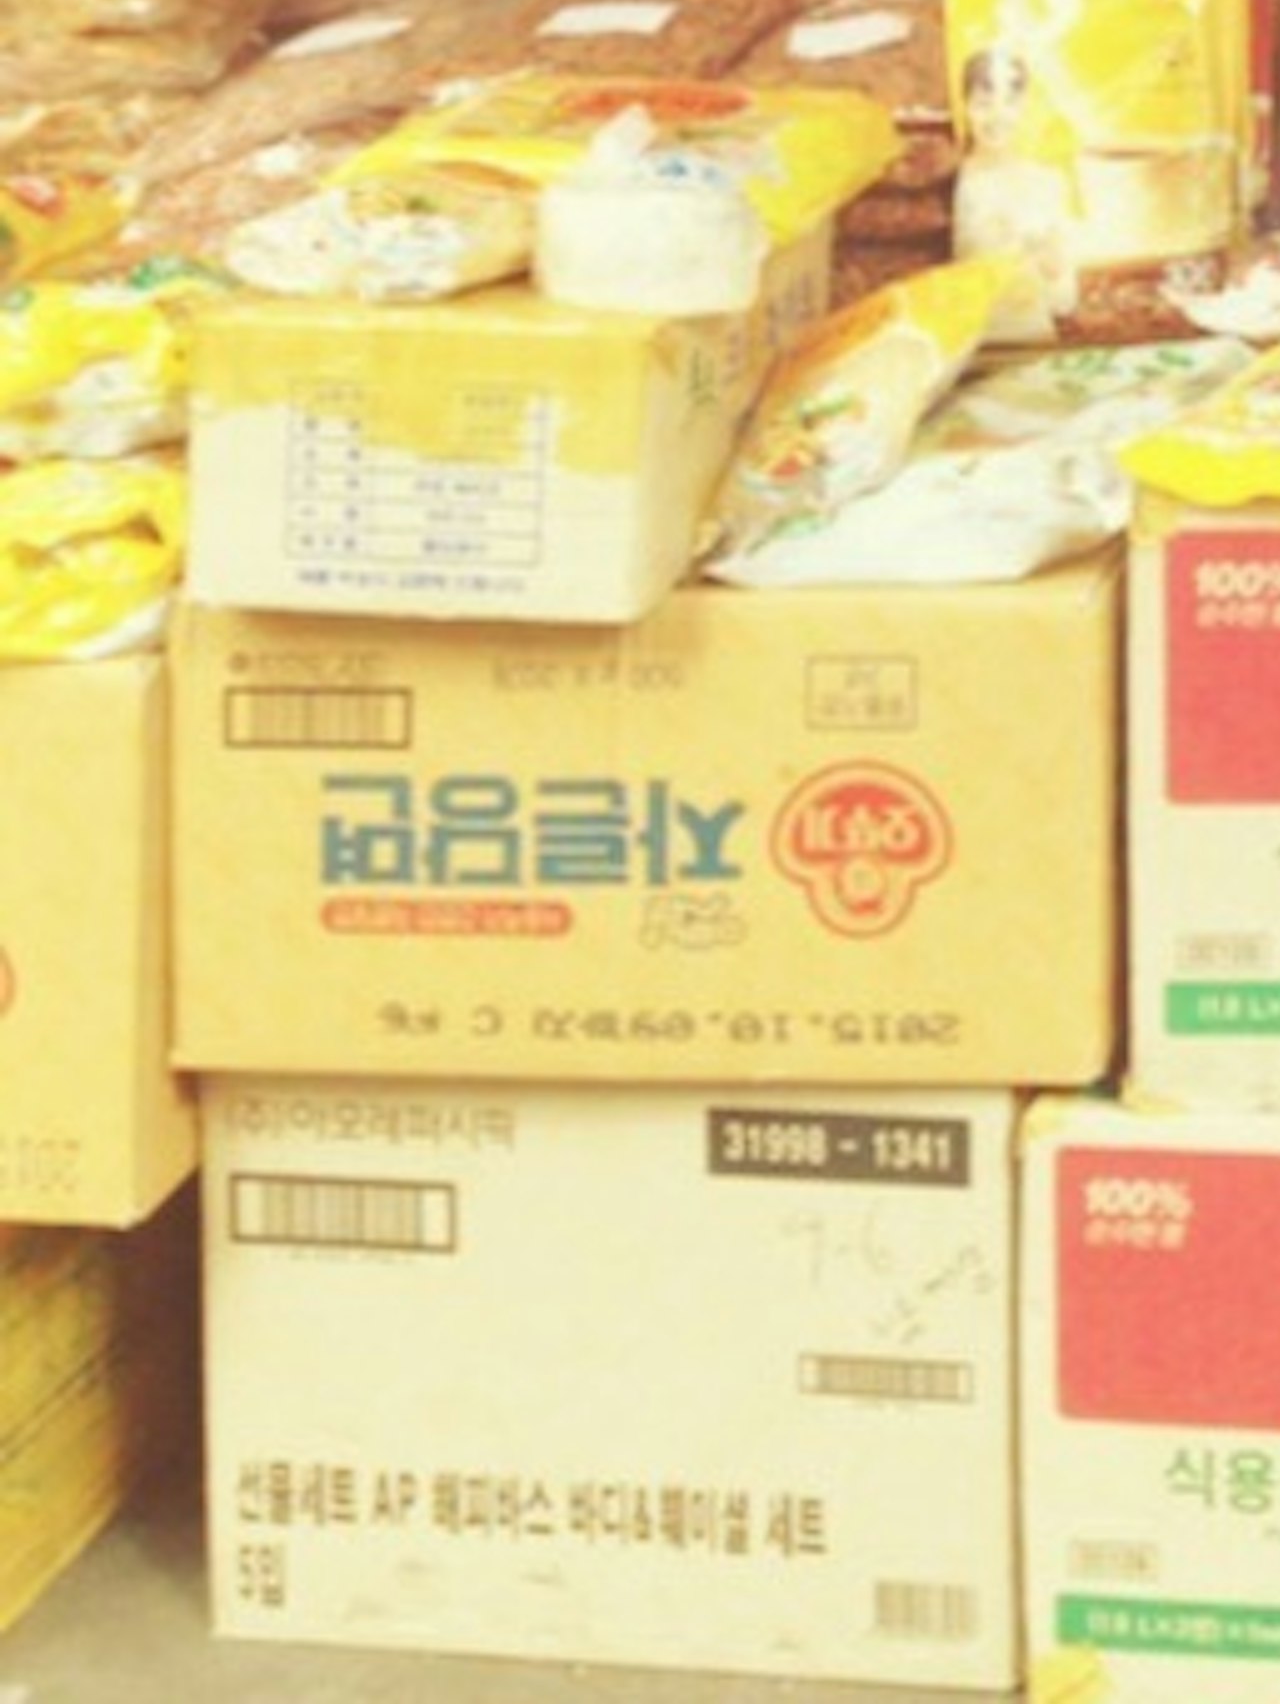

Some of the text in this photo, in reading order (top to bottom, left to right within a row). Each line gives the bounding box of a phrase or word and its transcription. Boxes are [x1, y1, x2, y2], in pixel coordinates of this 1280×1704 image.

[319, 774, 745, 887] 자른당면
[721, 1121, 826, 1166] 31998
[872, 1127, 953, 1169] 1341
[1085, 1177, 1193, 1219] 100%
[239, 1462, 357, 1526] 선물세트
[370, 1469, 418, 1523] AP
[764, 1492, 827, 1558] 세트
